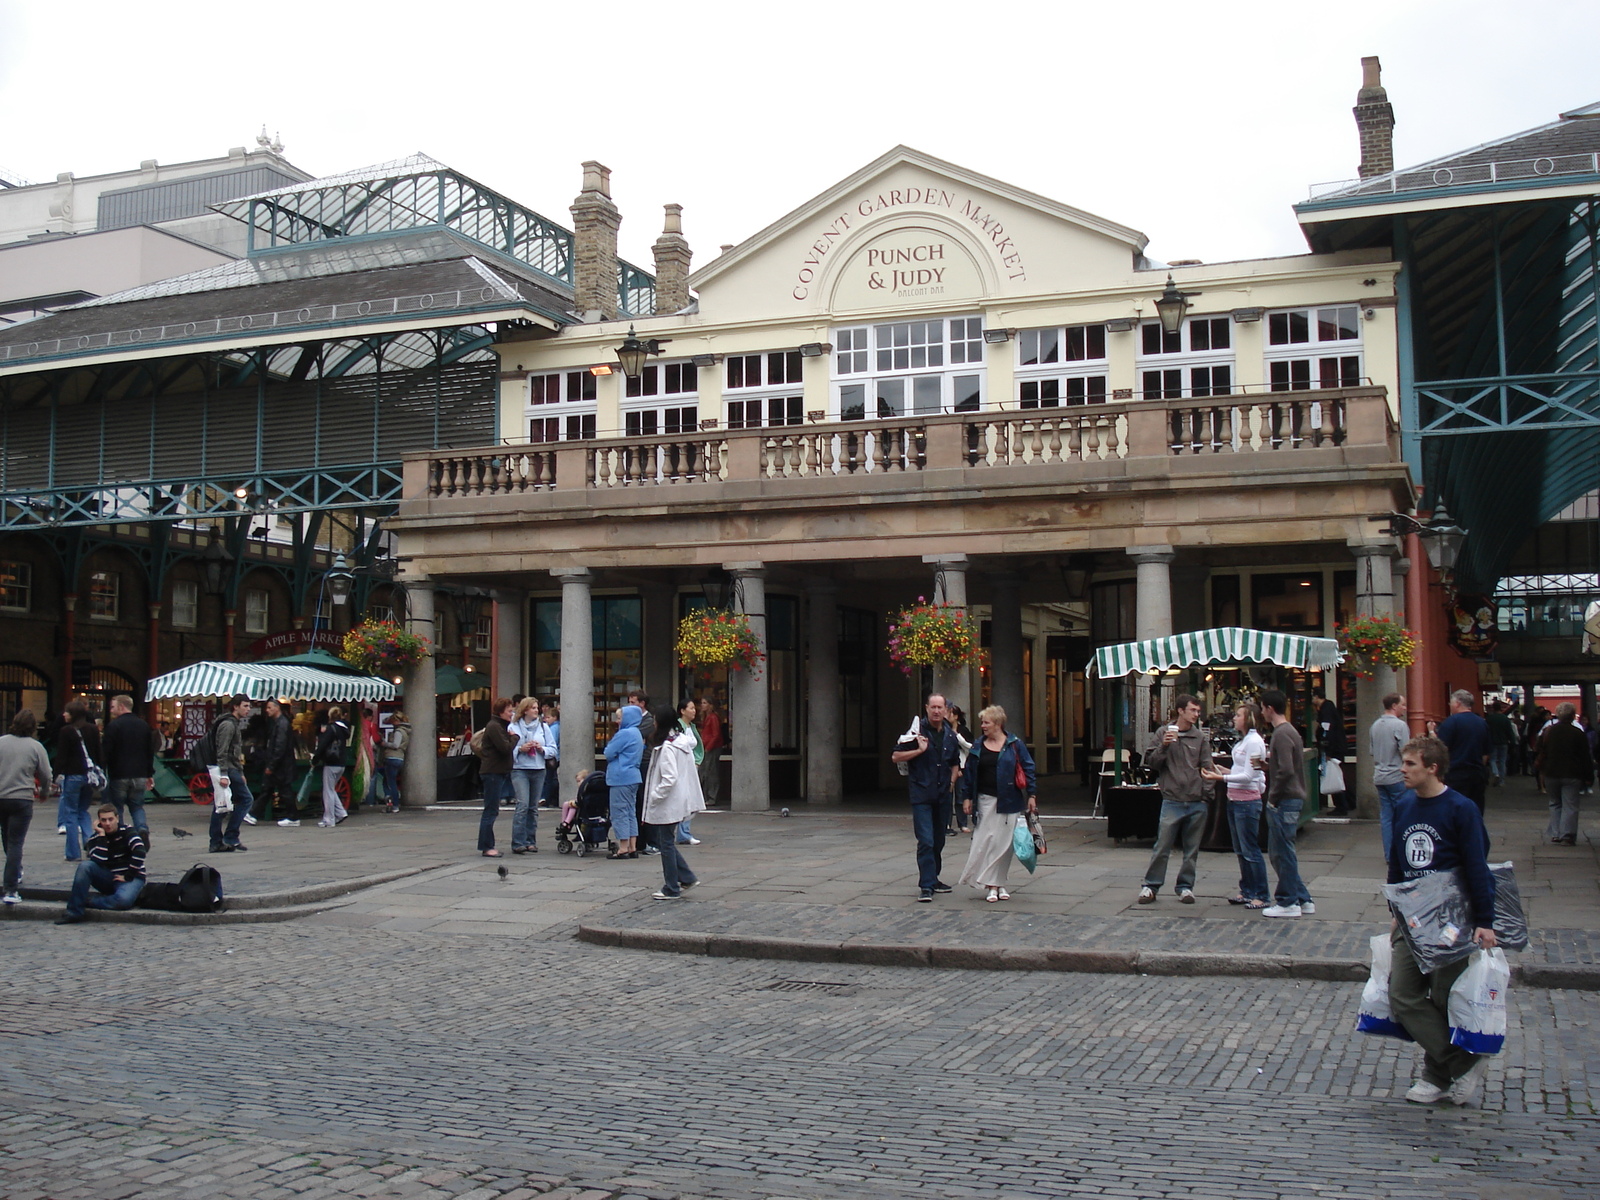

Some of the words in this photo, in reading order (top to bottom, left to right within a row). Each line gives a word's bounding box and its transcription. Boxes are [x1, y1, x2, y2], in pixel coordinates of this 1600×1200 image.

[792, 212, 852, 301] COVENT
[858, 187, 956, 217] GARDEN
[959, 199, 1027, 283] MARKET
[867, 244, 945, 266] PUNCH
[868, 272, 888, 290] &
[891, 267, 946, 293] JUDY
[930, 286, 945, 295] BAR
[265, 633, 296, 649] APPLE
[301, 632, 343, 645] MARKE
[1402, 823, 1443, 841] OKTOBERFEST
[1411, 850, 1425, 861] HB
